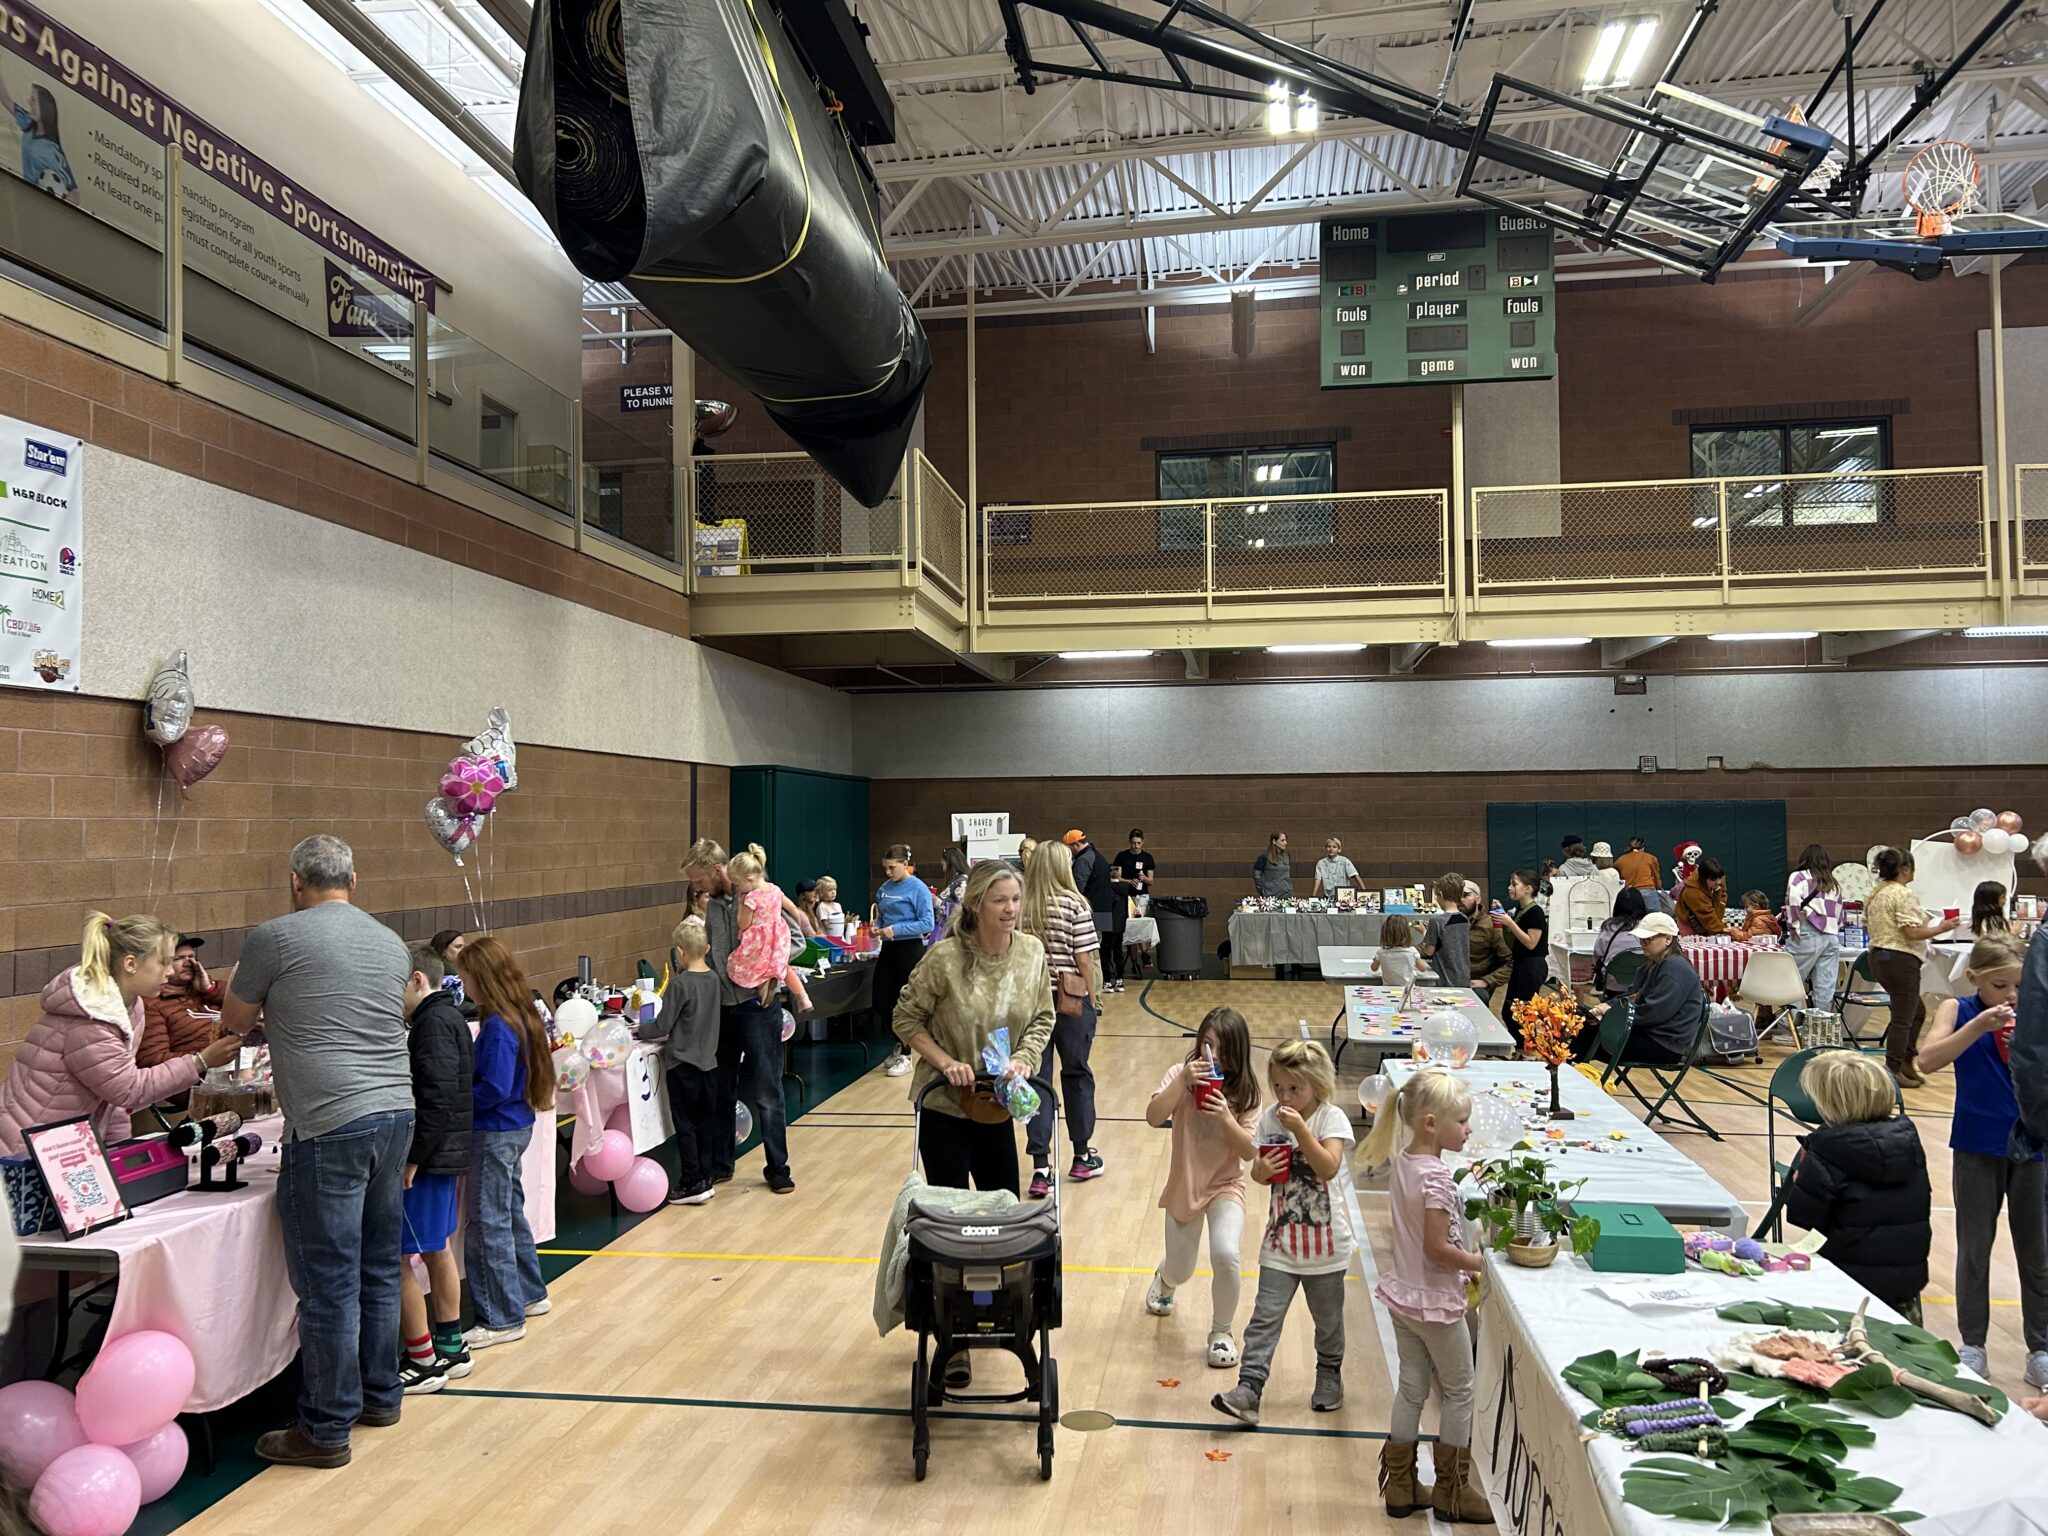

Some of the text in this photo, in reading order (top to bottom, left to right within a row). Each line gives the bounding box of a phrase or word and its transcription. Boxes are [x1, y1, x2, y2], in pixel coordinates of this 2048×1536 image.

[36, 25, 155, 127] Against
[163, 104, 275, 204] Negative
[281, 185, 425, 303] Sportsmanship
[95, 130, 149, 174] Mandatory
[219, 208, 255, 236] program
[94, 152, 140, 189] Required
[181, 206, 228, 241] egistration
[229, 232, 241, 247] for
[242, 242, 253, 254] all
[253, 247, 277, 268] youth
[278, 262, 302, 282] sports
[1332, 225, 1369, 241] Home
[93, 175, 106, 192] At
[107, 181, 132, 207] least
[133, 200, 153, 217] one
[186, 229, 209, 250] must
[210, 243, 250, 272] complete
[250, 266, 277, 288] course
[278, 281, 310, 308] annually
[1416, 271, 1460, 290] period
[329, 274, 378, 325] Fans
[1507, 298, 1539, 313] fouls
[1336, 307, 1367, 322] fouls
[1416, 301, 1460, 319] player
[1421, 360, 1455, 375] game
[1511, 356, 1538, 368] won
[1340, 364, 1366, 376] won
[623, 387, 661, 397] PLEASE
[626, 397, 674, 408] TO RUNNE
[28, 444, 66, 467] Stor'em
[12, 487, 68, 509] H&R BLOCK
[968, 818, 993, 827] SHAVED
[975, 828, 987, 838] ICE
[961, 1225, 999, 1236] doona
